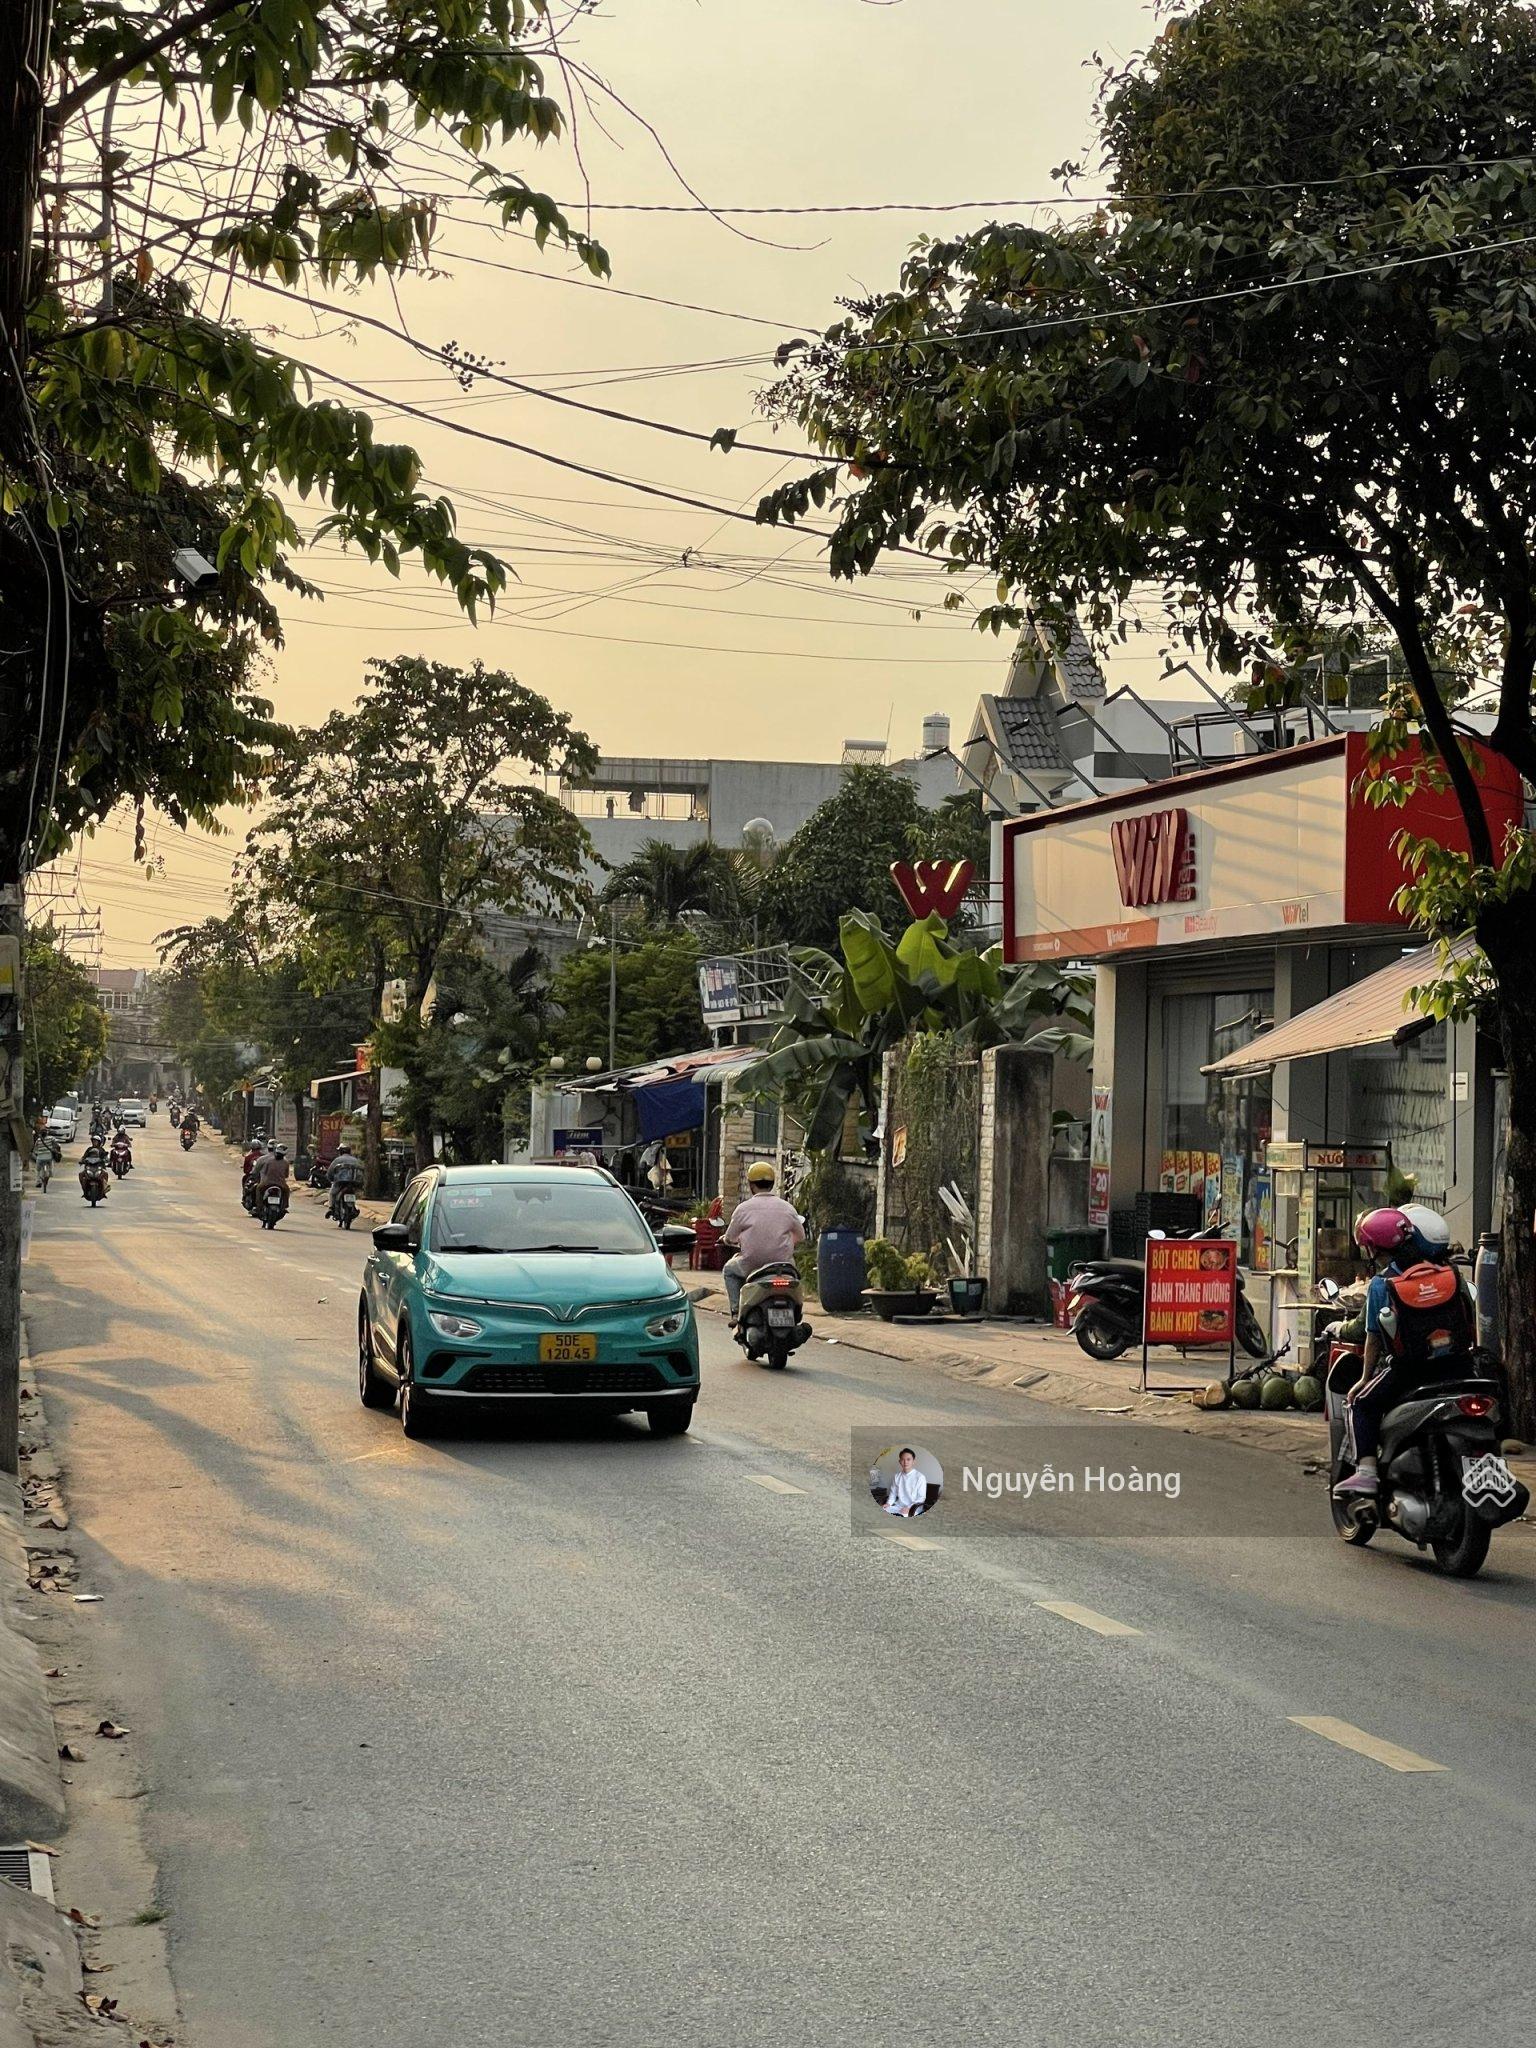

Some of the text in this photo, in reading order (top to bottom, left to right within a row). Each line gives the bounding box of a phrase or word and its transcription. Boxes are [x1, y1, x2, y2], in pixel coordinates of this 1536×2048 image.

[1152, 1245, 1170, 1274] BỘT
[1151, 1278, 1173, 1303] BÁNH
[1175, 1279, 1200, 1303] TRÁNG
[1150, 1307, 1174, 1332] BÁNH
[555, 1334, 581, 1347] 50E
[546, 1347, 590, 1360] 120.45
